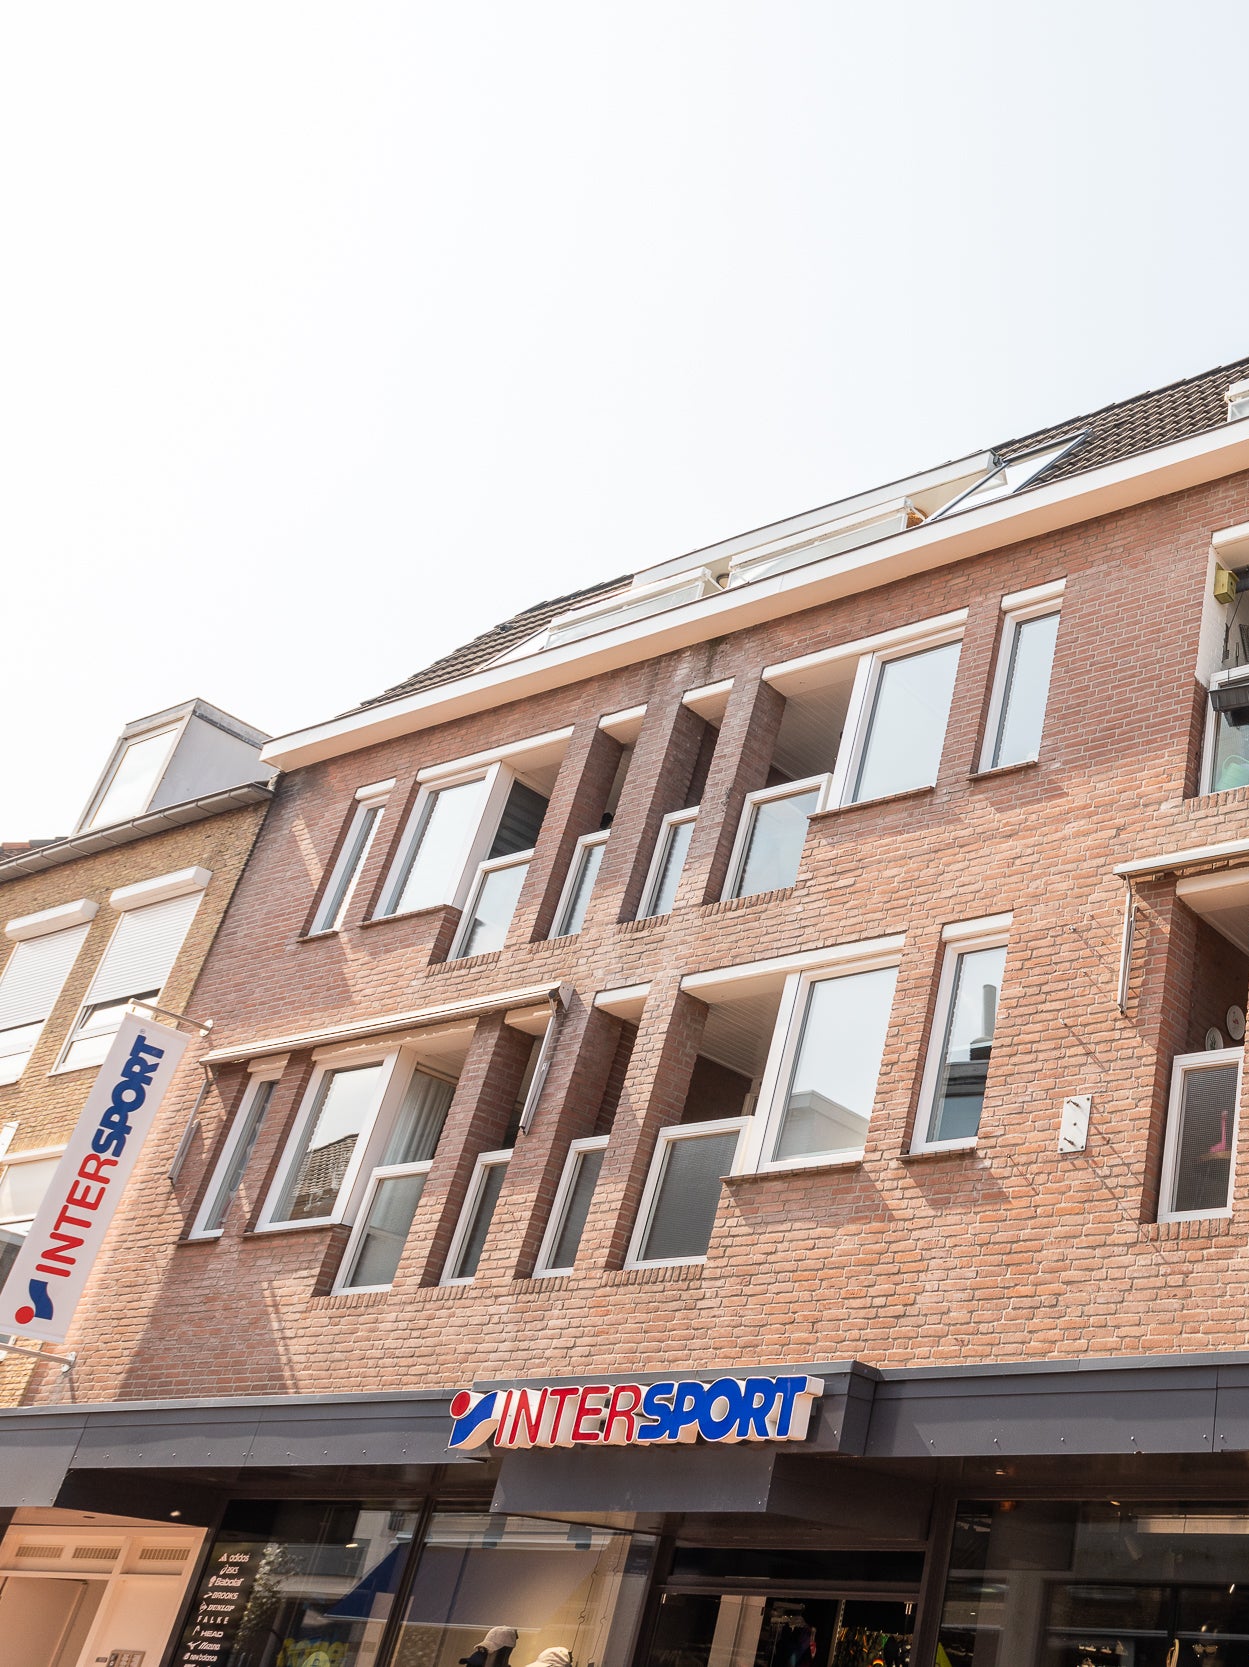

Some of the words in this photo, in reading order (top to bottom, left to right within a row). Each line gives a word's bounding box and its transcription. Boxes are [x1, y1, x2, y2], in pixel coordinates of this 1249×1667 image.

[36, 1034, 165, 1277] INTERSPORT
[493, 1375, 808, 1447] INTERSPORT
[229, 1553, 250, 1562] adidas
[215, 1578, 244, 1587] Babolat
[212, 1592, 239, 1600] BROOKS
[207, 1604, 235, 1612] DUNLOP
[197, 1615, 229, 1624] FALKE
[200, 1630, 224, 1638] HEAD
